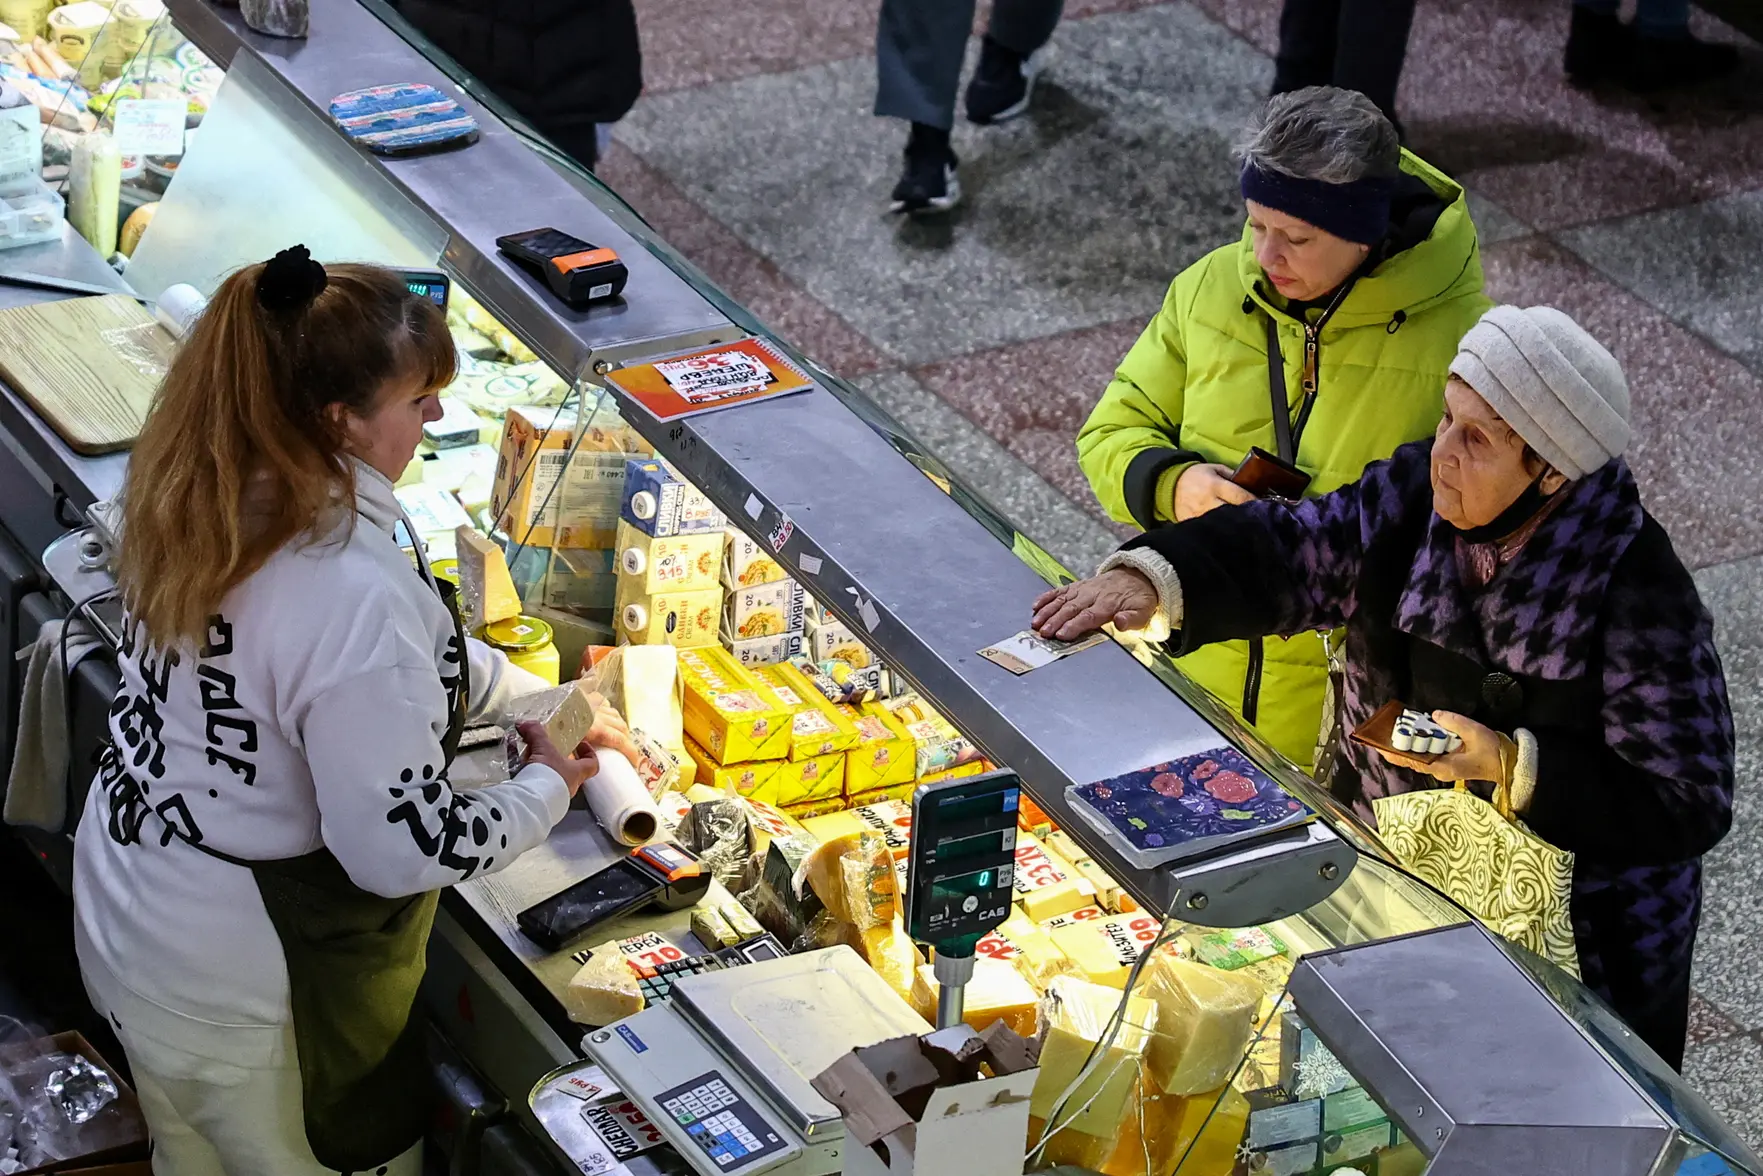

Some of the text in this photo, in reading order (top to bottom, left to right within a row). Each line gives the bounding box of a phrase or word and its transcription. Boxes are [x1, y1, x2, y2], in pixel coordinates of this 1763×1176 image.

[659, 485, 676, 536] СЛИВКИ
[981, 648, 999, 657] 20
[979, 871, 988, 886] 0
[978, 905, 1005, 920] CAS
[618, 1024, 634, 1043] CAS
[587, 1106, 637, 1156] CHEDDAR
